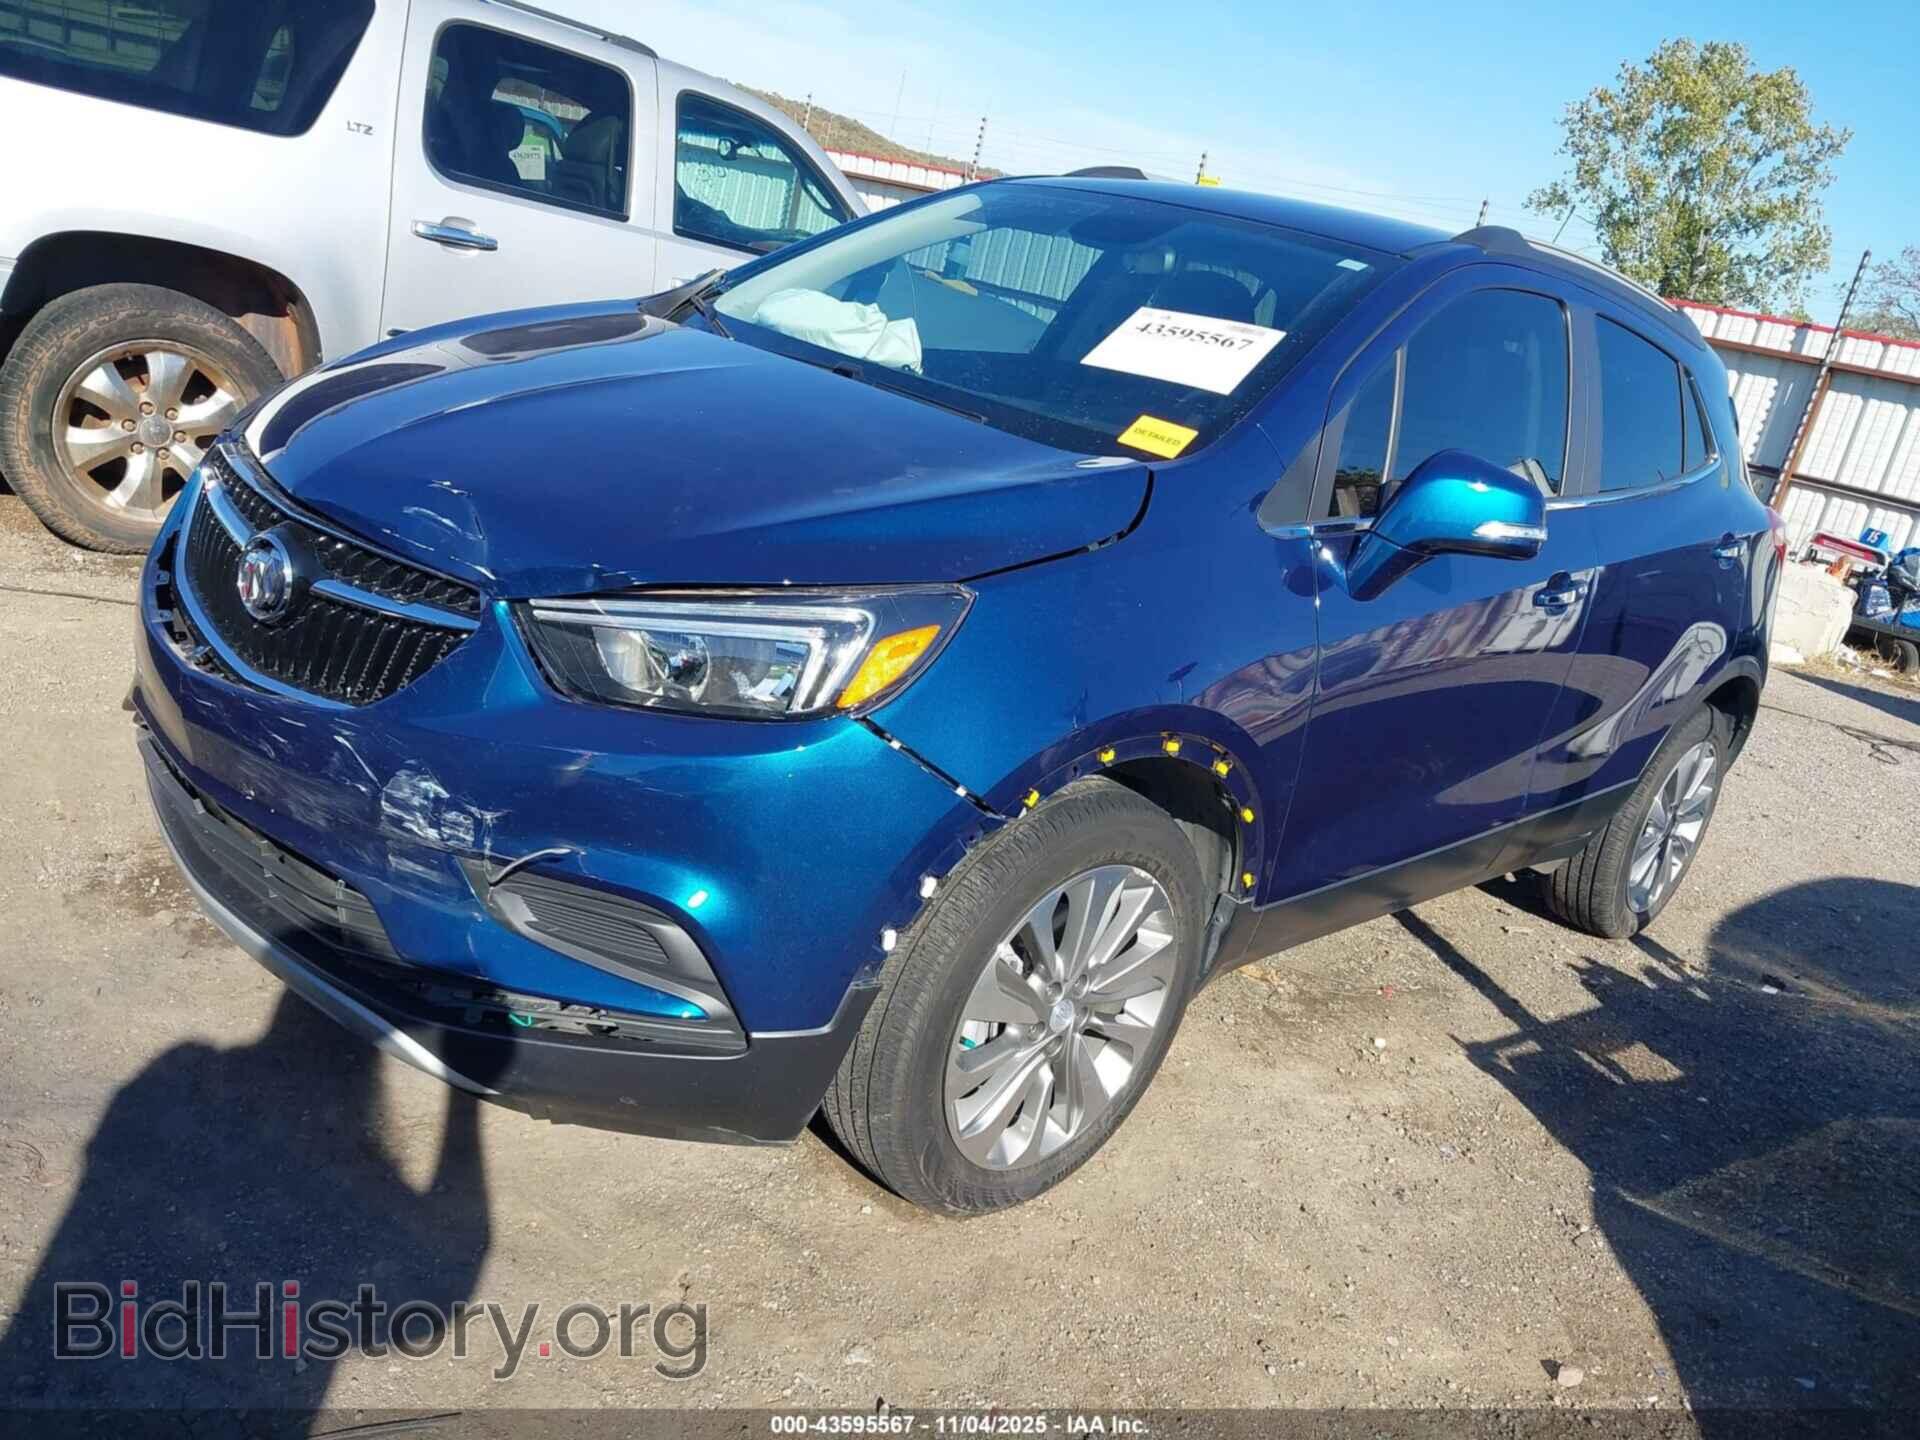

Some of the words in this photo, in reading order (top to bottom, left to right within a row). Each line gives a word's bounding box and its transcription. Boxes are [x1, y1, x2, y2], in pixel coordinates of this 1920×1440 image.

[347, 120, 373, 136] LTZ
[1136, 323, 1253, 350] 43595567
[1133, 427, 1182, 446] DETAILED
